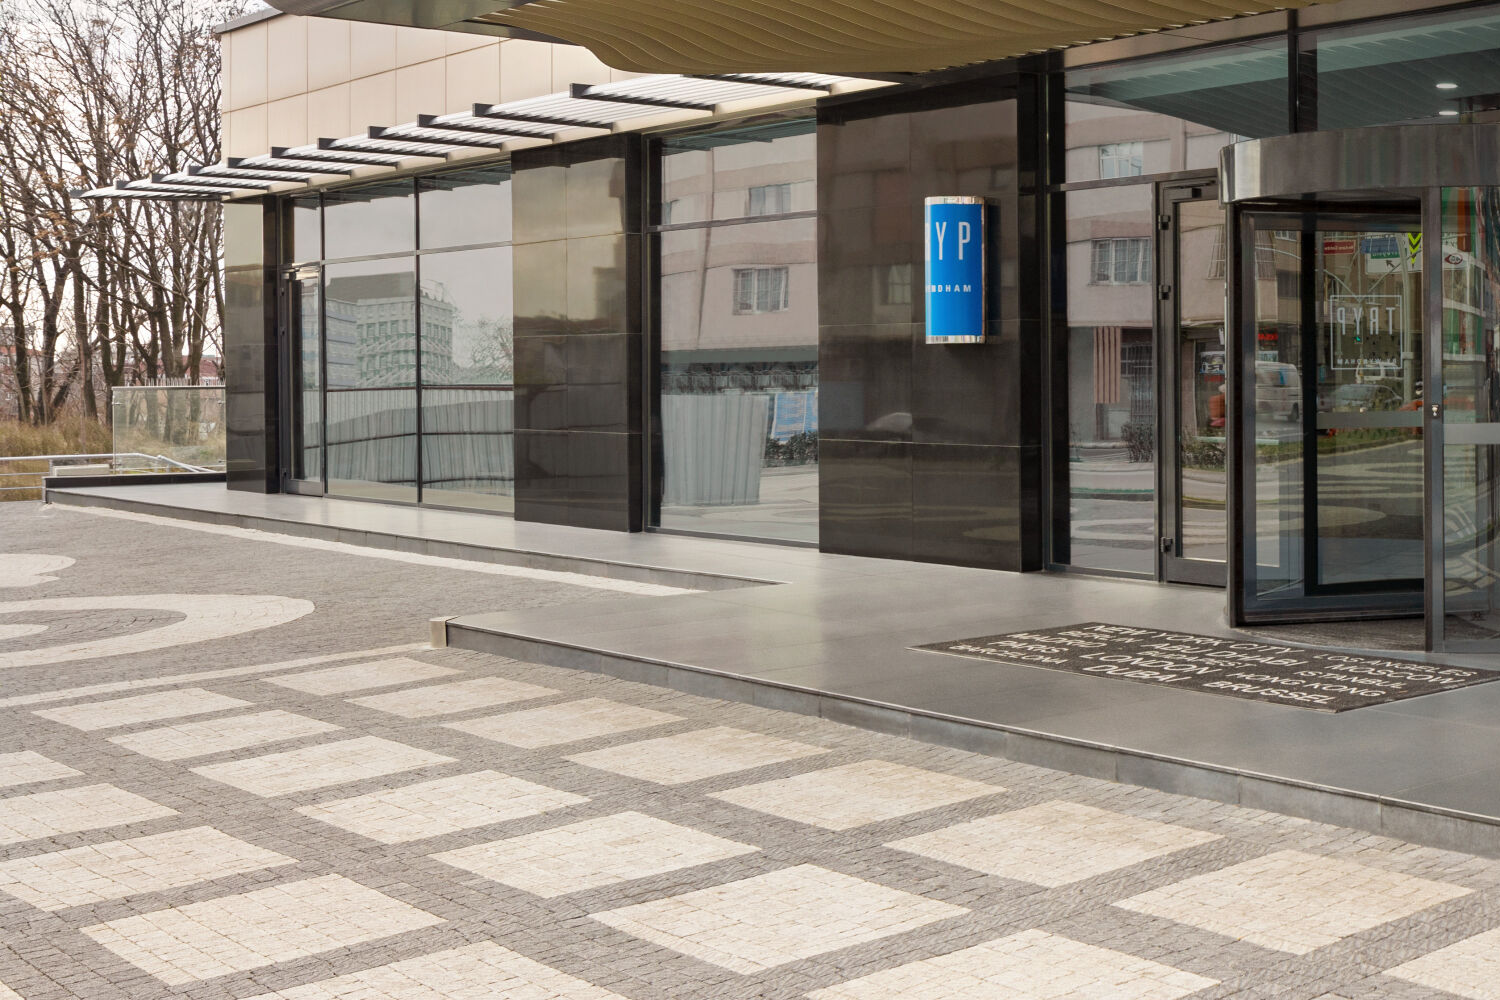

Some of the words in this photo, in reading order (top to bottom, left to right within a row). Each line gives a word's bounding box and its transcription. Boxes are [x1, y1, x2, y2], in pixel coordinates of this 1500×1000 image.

[925, 221, 971, 261] YP
[988, 640, 1068, 653] PARIS
[1006, 632, 1107, 647] MADRID
[1057, 630, 1141, 643] BERLIN
[1083, 625, 1155, 635] NEW
[1151, 632, 1232, 645] YORK
[1228, 643, 1304, 653] CITY
[1079, 652, 1222, 674] LONDON
[1141, 643, 1212, 653] ABU
[1205, 650, 1307, 666] DHABI
[1312, 653, 1364, 662] LOS
[1360, 660, 1477, 676] ANGELES
[1082, 664, 1191, 682] DUBAI
[1226, 672, 1306, 685] HONG
[1303, 682, 1386, 696] KONG
[1293, 670, 1405, 688] ISTANBUL
[1324, 663, 1464, 683] MOSCOW
[1202, 680, 1334, 703] BRUSSEL
